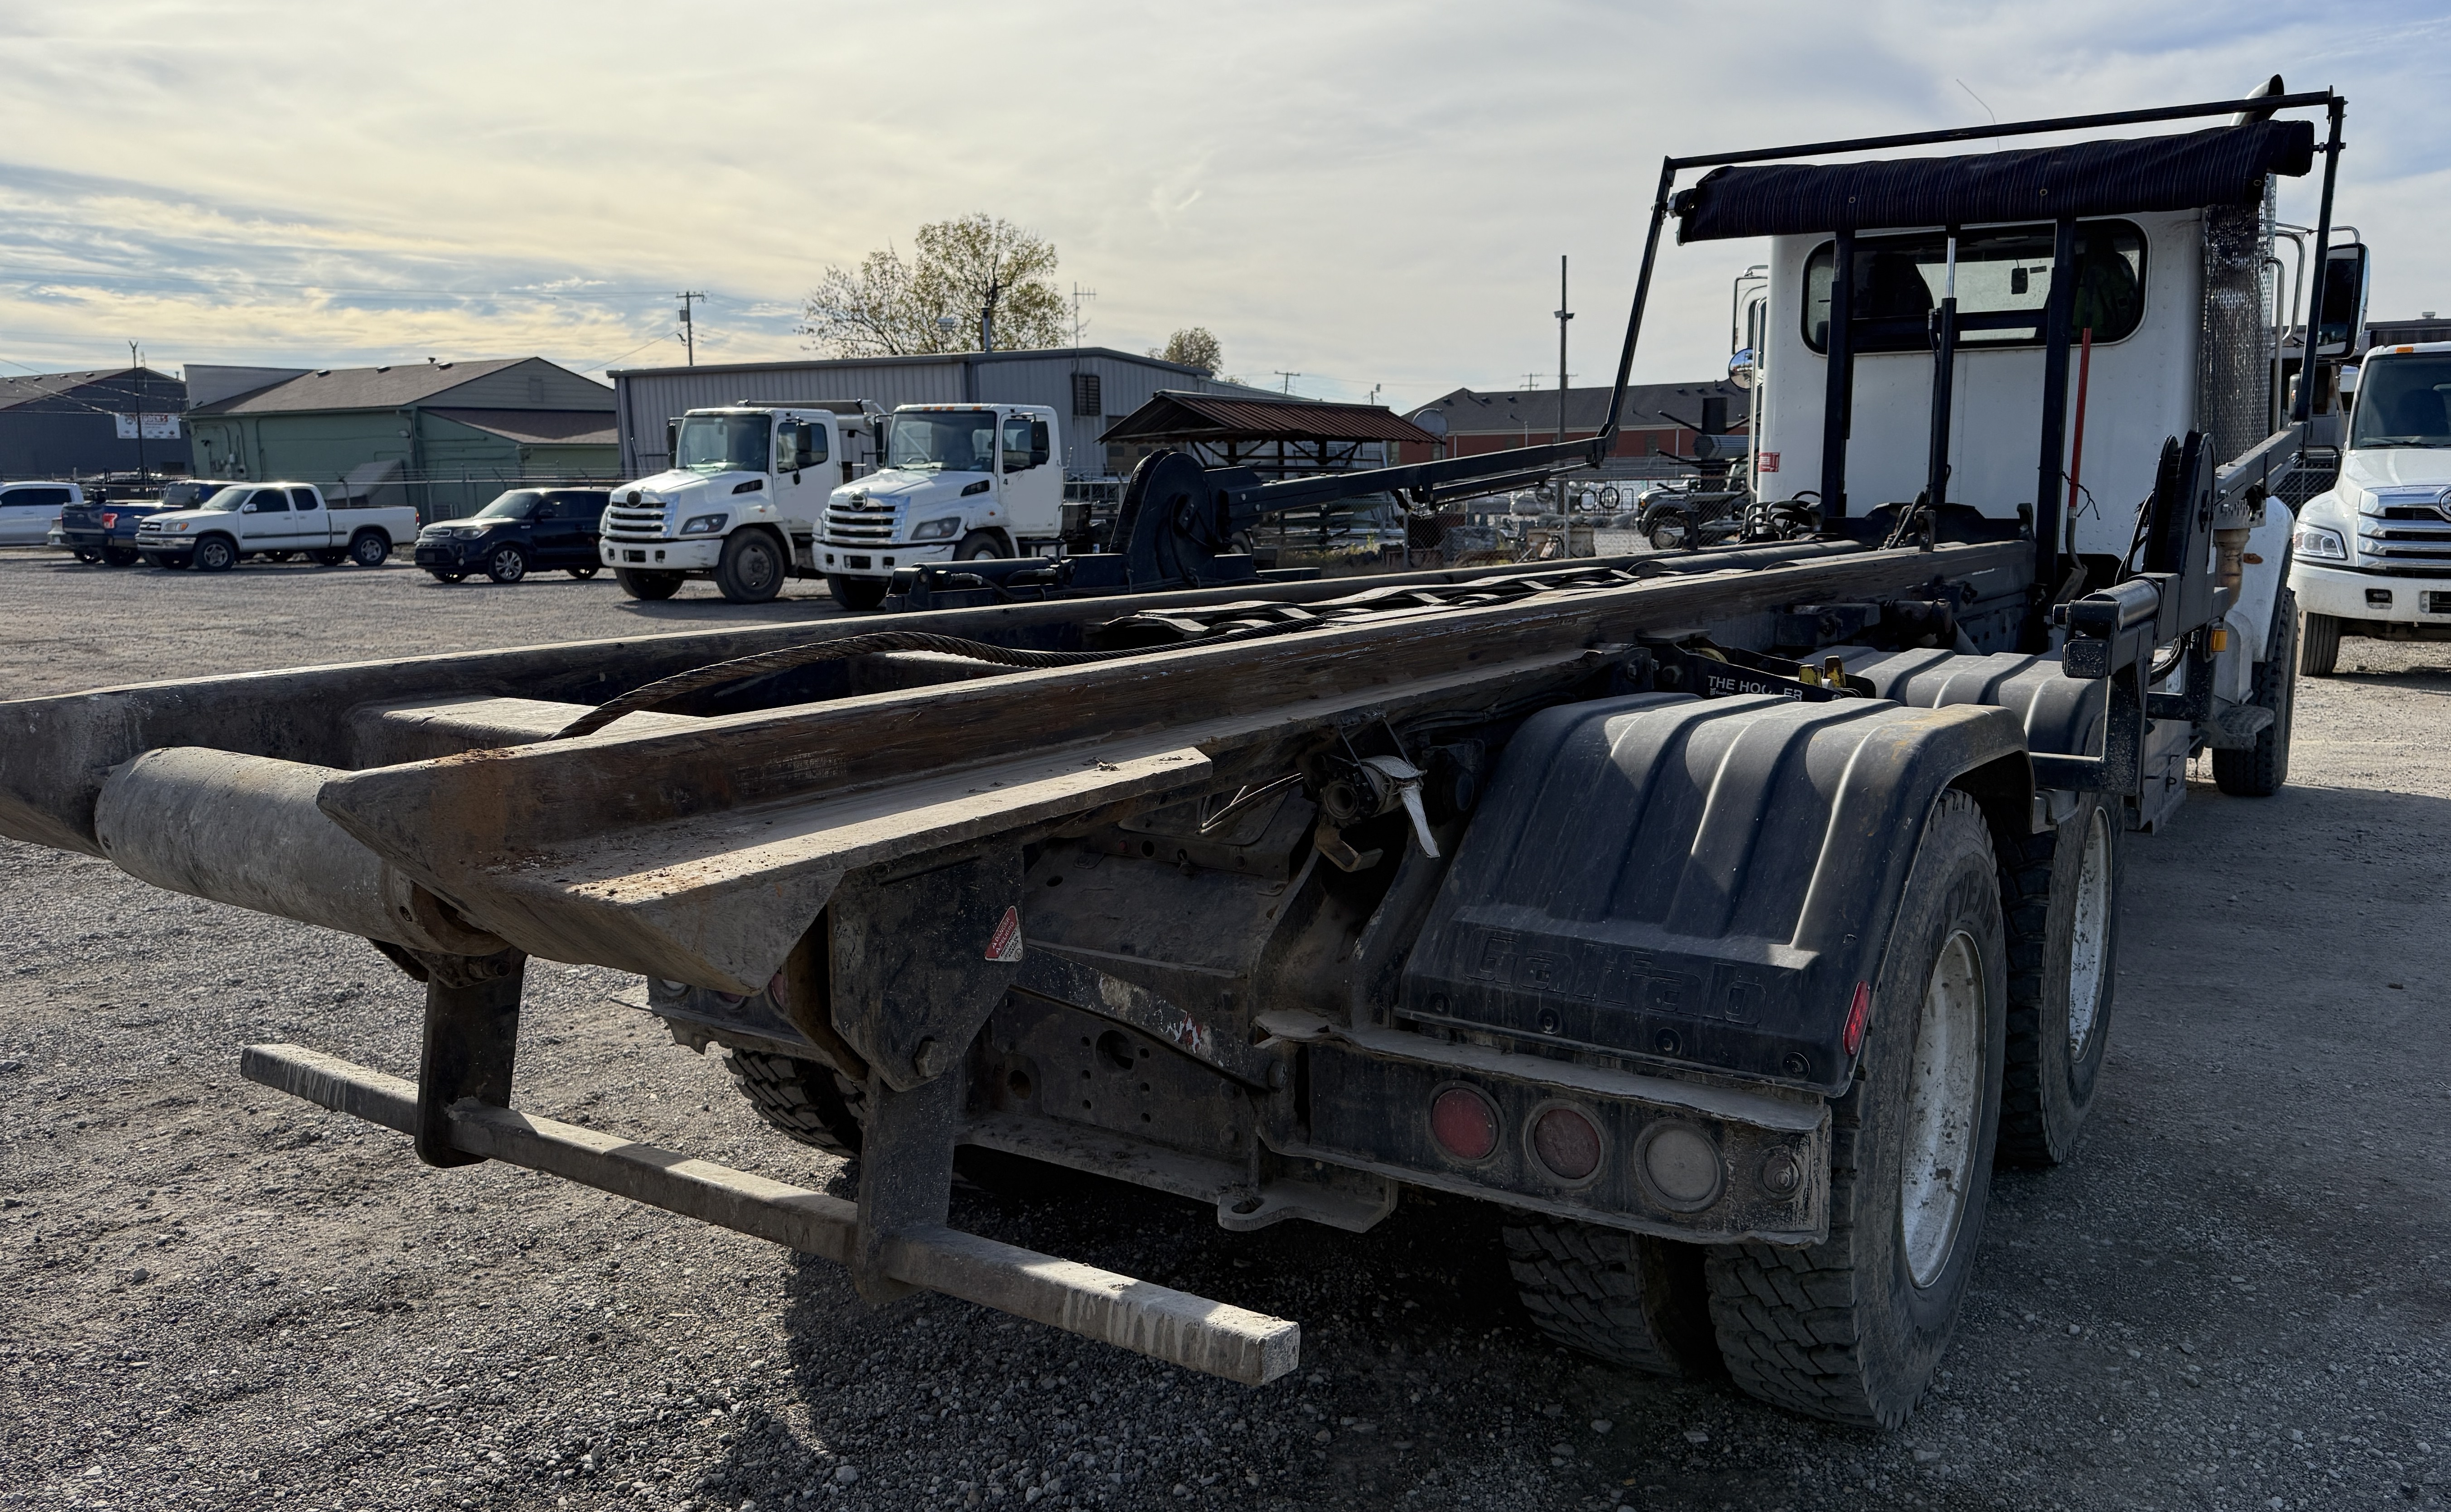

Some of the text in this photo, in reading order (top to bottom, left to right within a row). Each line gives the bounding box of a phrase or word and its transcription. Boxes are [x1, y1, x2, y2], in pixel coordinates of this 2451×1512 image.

[1708, 675, 1803, 701] THE HOER
[995, 917, 1010, 942] DANGER
[998, 922, 1014, 947] PELIGRO
[1463, 927, 1767, 1025] Galfab
